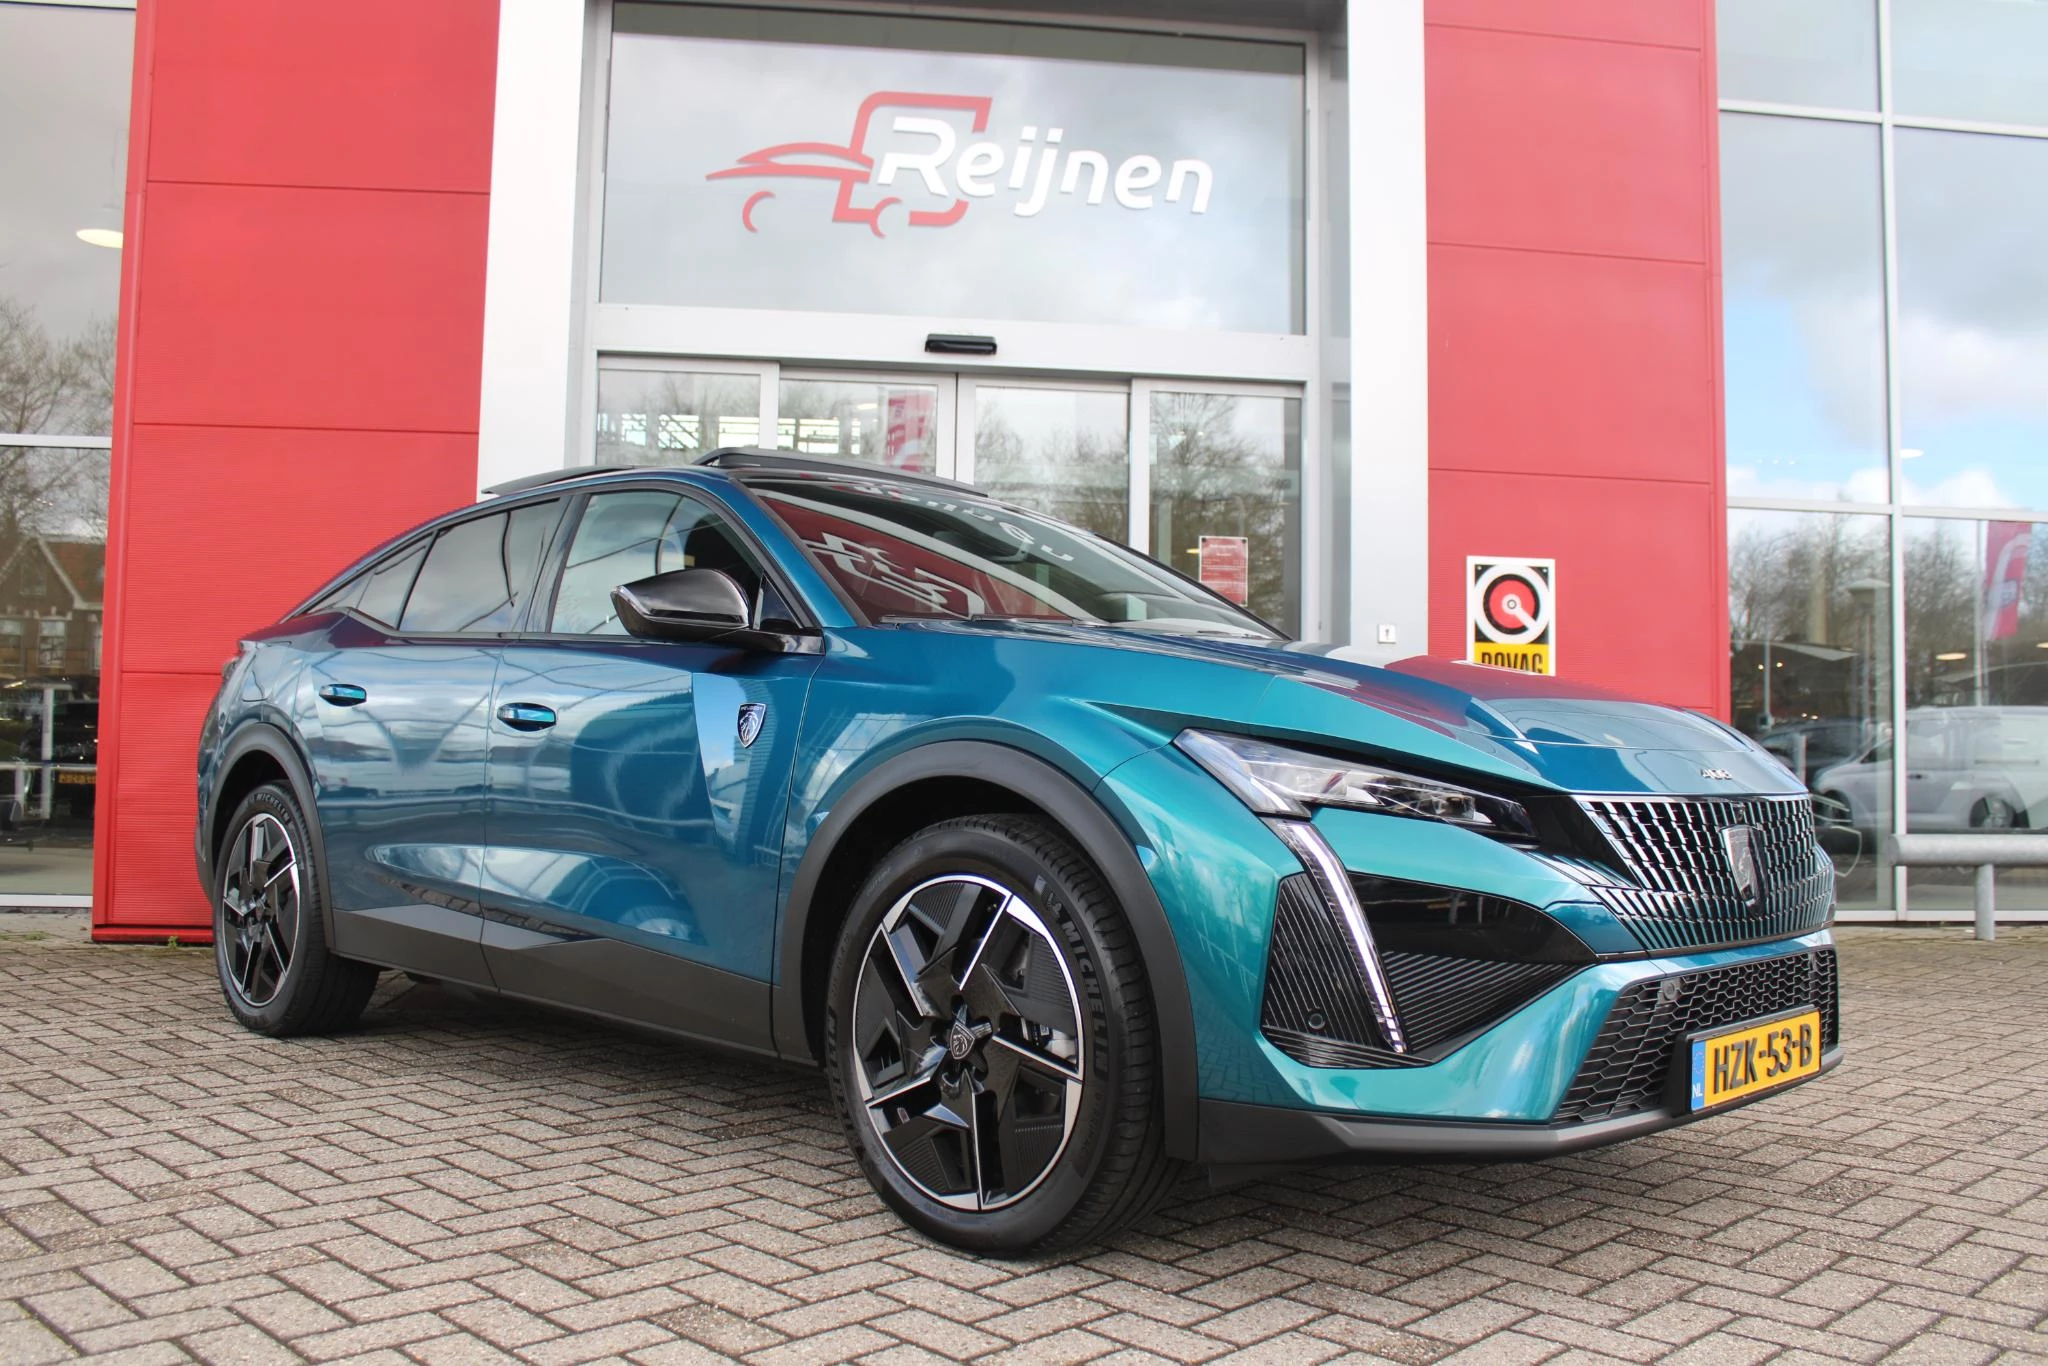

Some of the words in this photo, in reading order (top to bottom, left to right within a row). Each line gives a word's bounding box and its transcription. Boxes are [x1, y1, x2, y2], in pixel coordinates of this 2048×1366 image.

[877, 115, 1214, 217] Reijnen
[1062, 920, 1108, 1073] MICHELIN
[1692, 1083, 1703, 1098] NL
[1713, 1024, 1813, 1095] HZK-53-B
